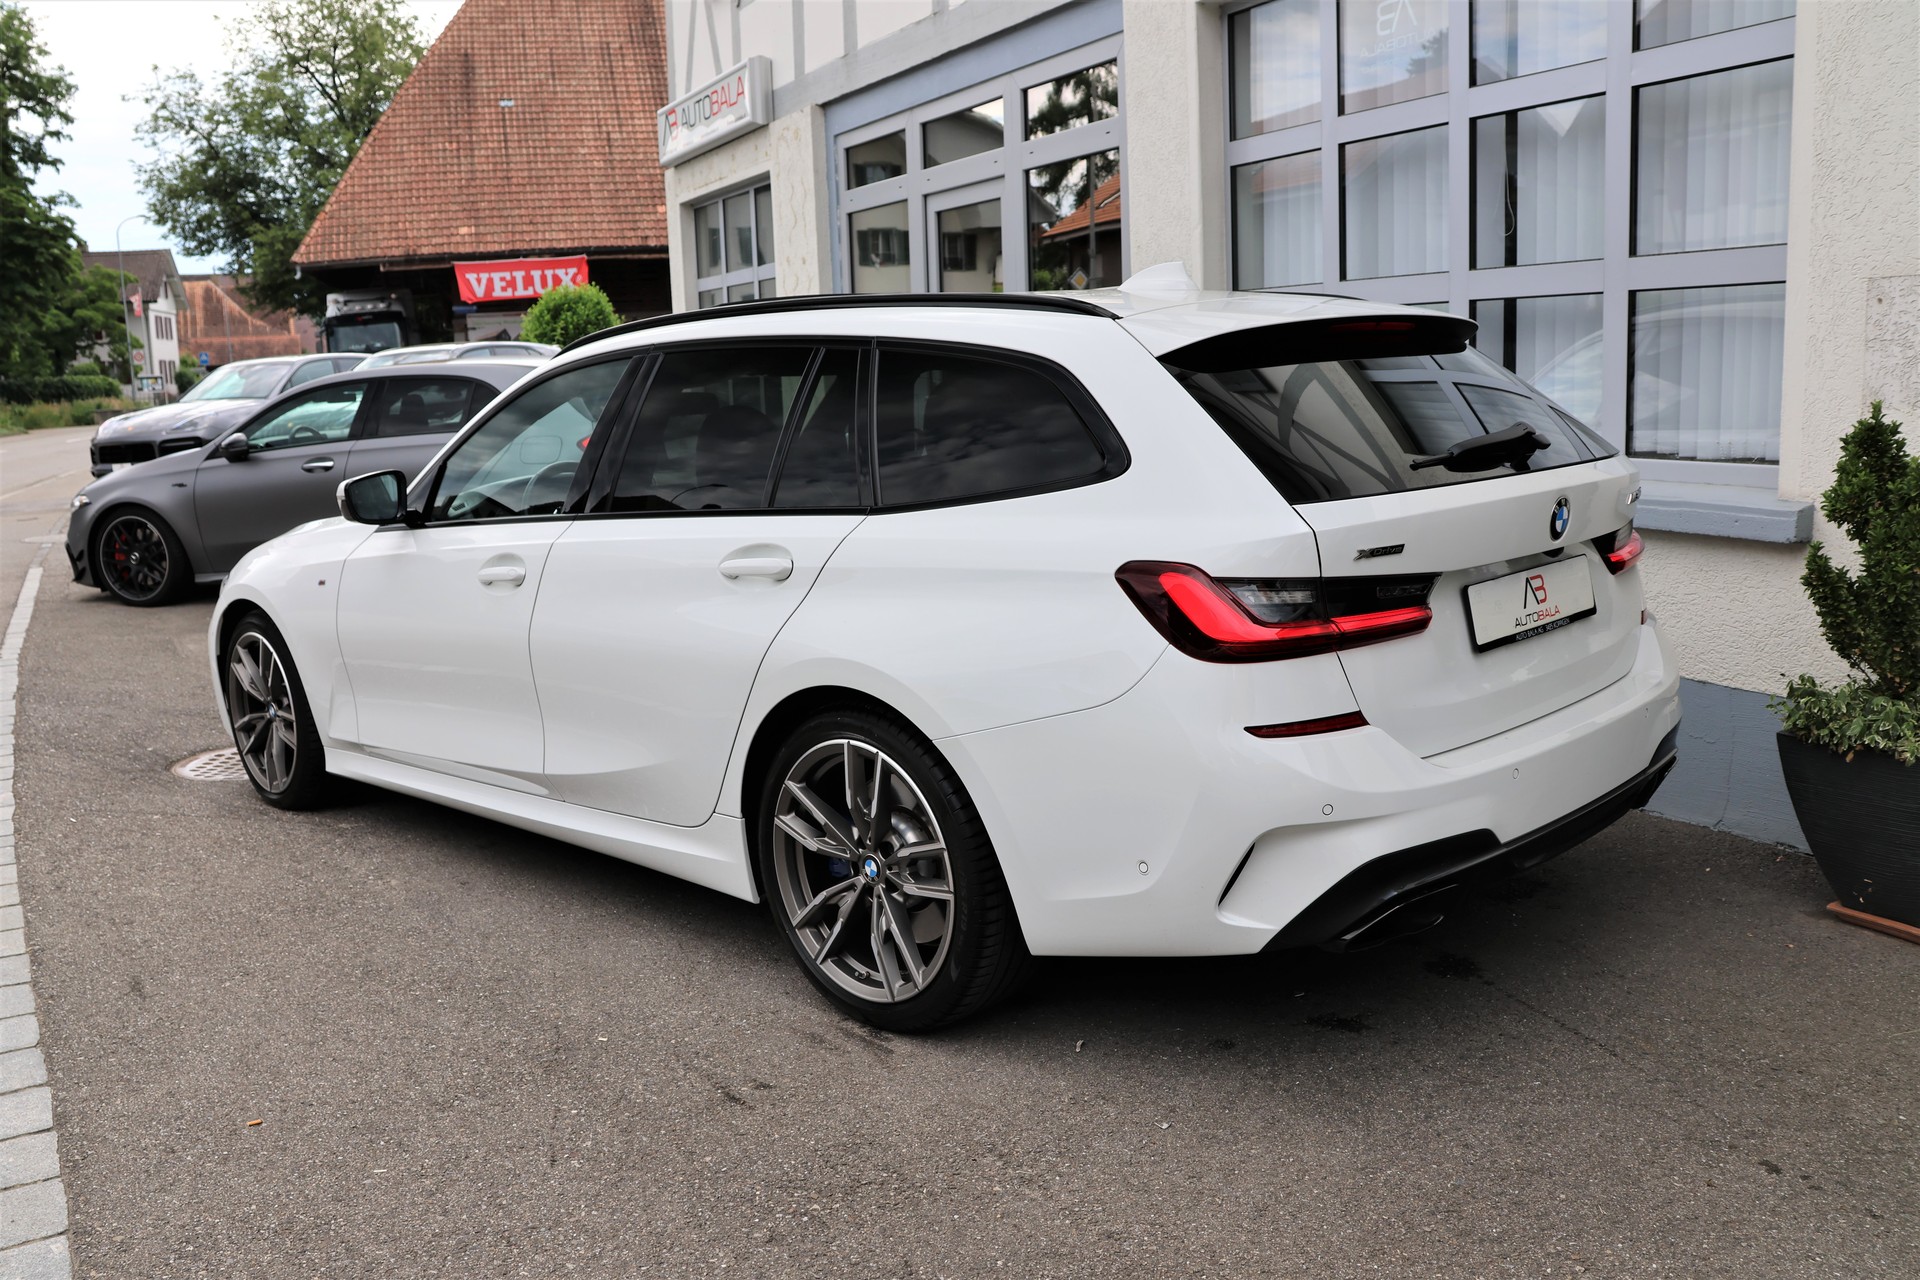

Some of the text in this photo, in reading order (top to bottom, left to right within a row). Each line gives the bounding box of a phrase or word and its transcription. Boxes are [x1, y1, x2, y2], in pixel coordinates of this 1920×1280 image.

[681, 76, 745, 128] AUTOBALA
[465, 267, 578, 298] VELUX
[1514, 605, 1561, 629] AUTOBALA
